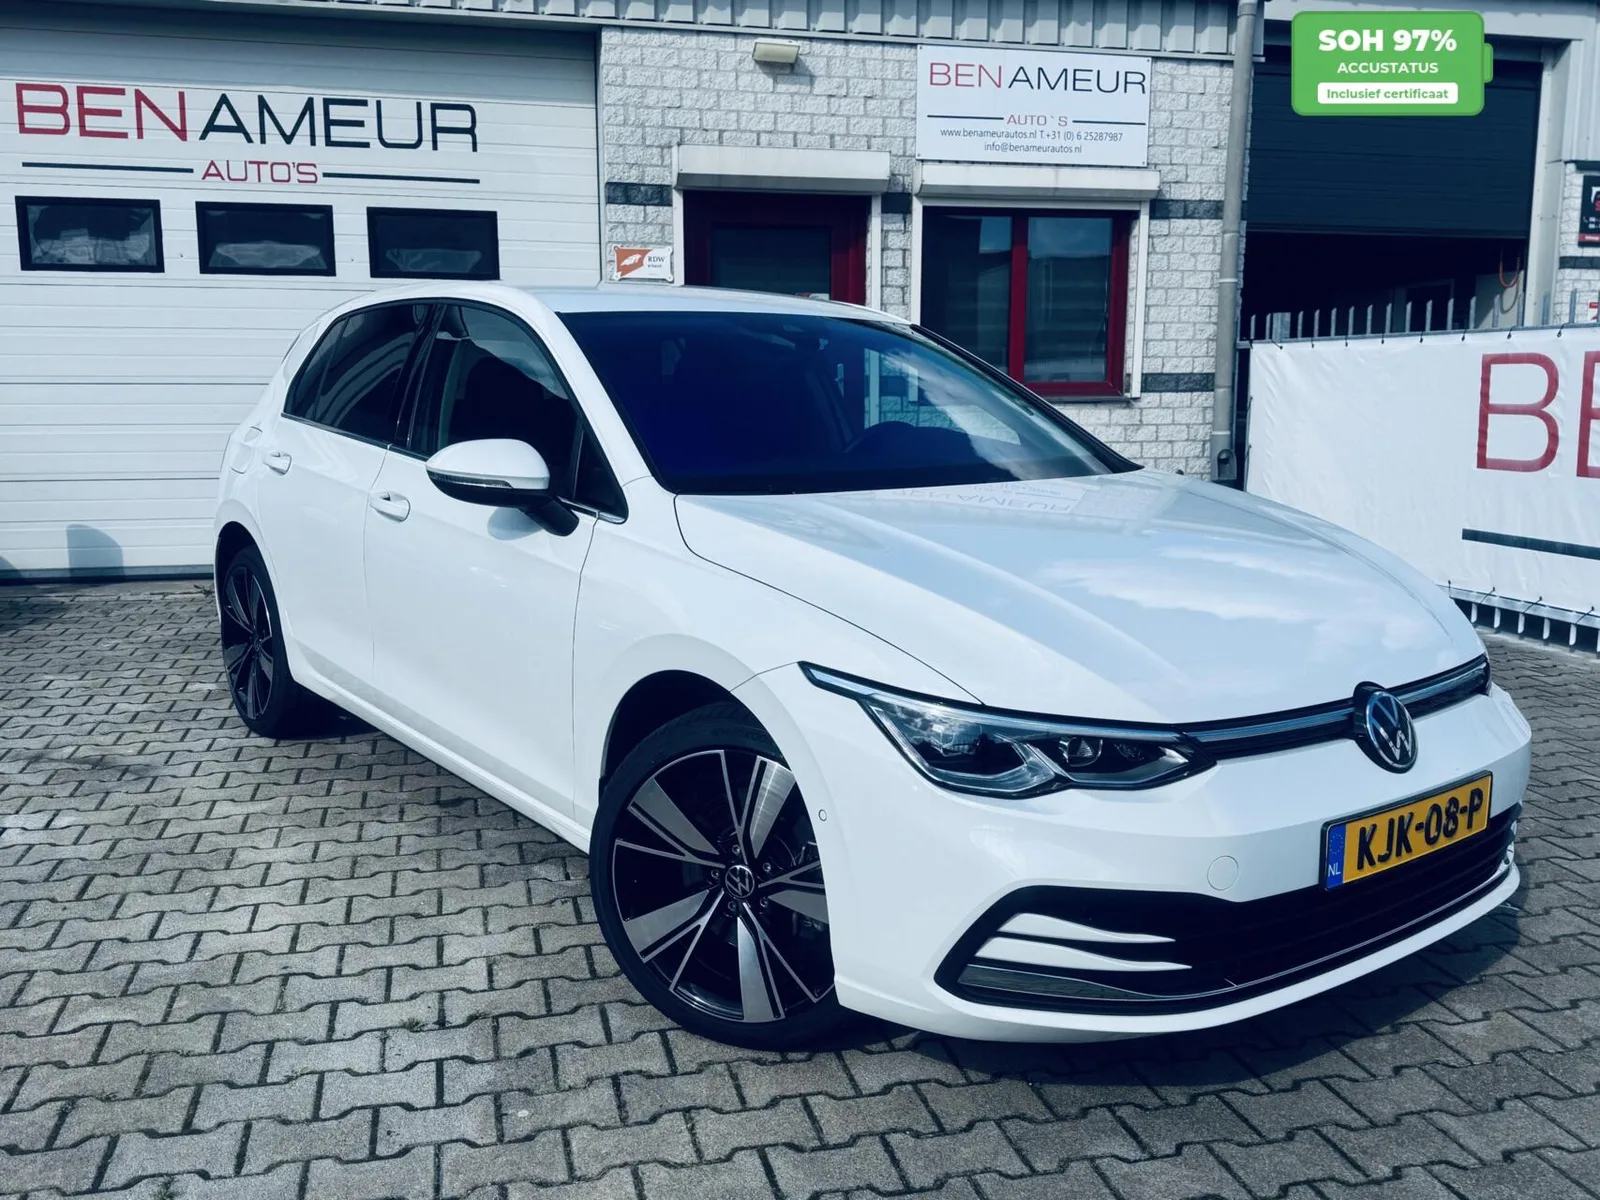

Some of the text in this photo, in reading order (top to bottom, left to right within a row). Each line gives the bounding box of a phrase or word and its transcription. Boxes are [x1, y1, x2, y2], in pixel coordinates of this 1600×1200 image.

[940, 127, 1038, 140] www.benameurautos.nl
[1063, 130, 1075, 142] (0)
[1076, 131, 1082, 141] 6
[1083, 131, 1124, 142] 25287987
[984, 141, 1083, 154] info@benameurautos.nl
[201, 159, 319, 185] AUTO'S
[1356, 787, 1484, 871] KJK-08-P
[1327, 863, 1342, 877] NL
